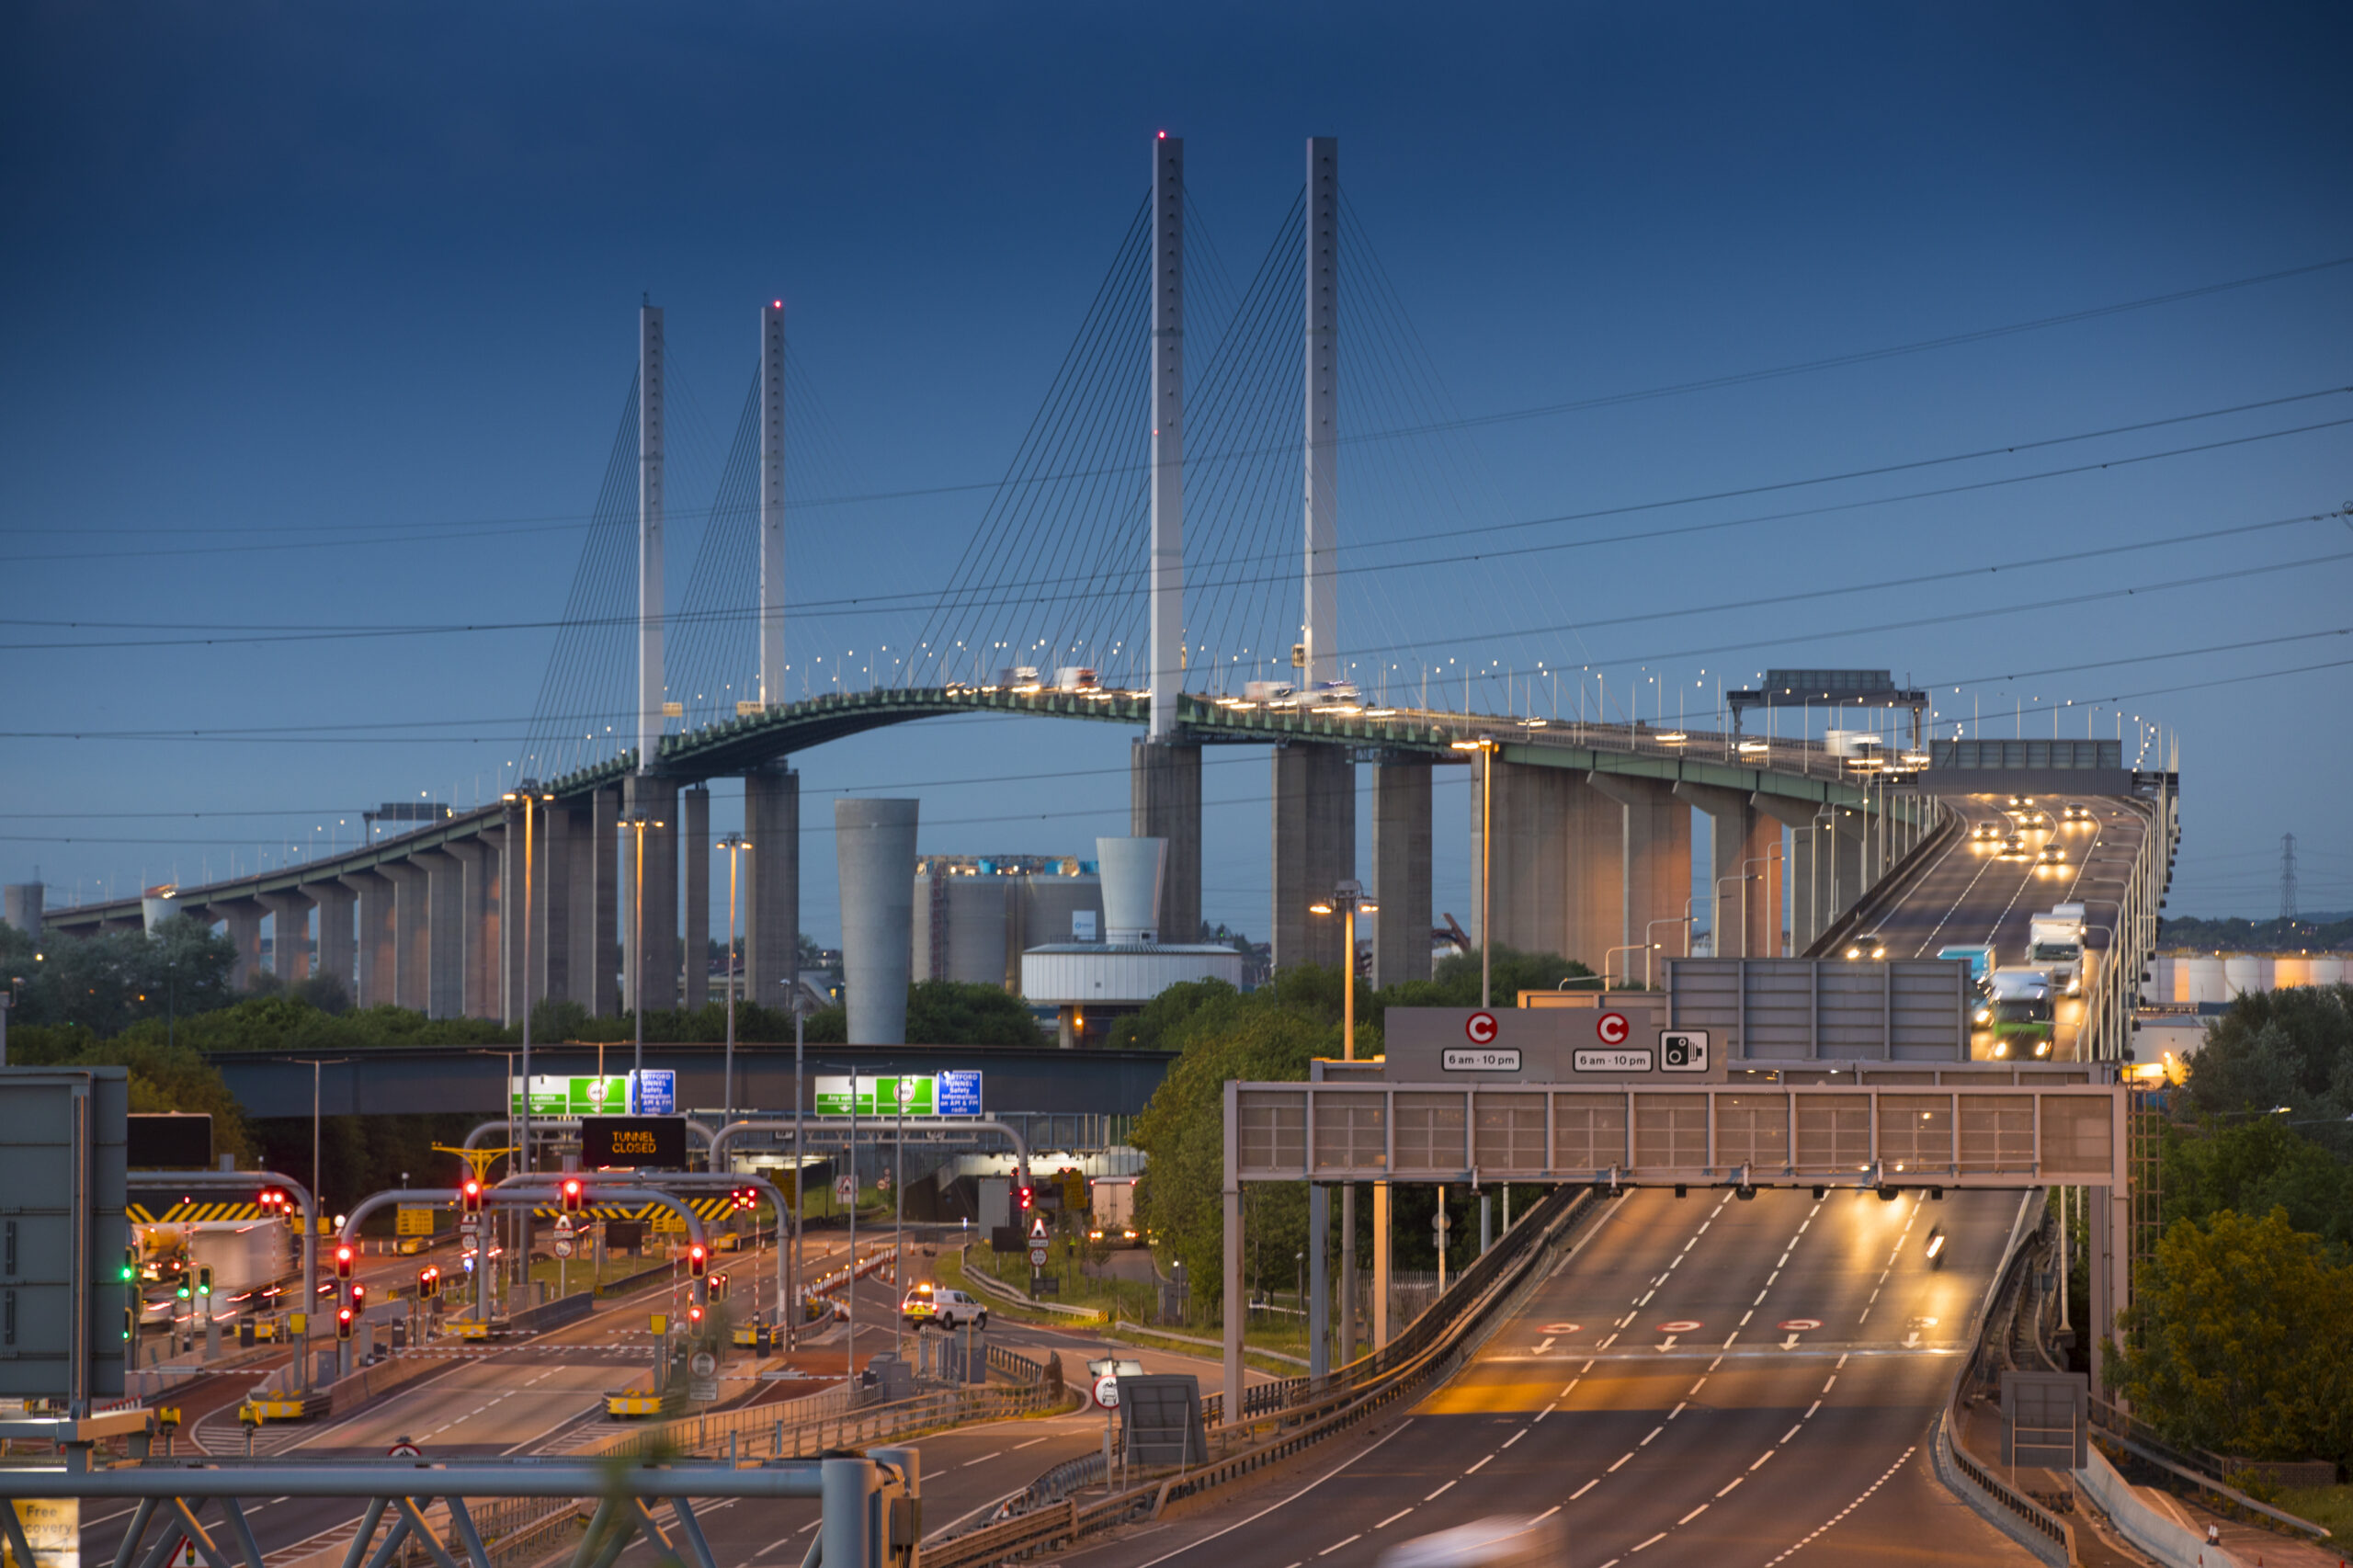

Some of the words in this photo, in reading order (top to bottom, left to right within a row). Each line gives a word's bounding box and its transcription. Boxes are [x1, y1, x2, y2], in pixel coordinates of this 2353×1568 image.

[1449, 1055, 1456, 1064] 6
[1458, 1056, 1474, 1064] am
[1483, 1055, 1495, 1064] 10
[1498, 1056, 1515, 1066] pm
[1580, 1055, 1587, 1065] 6
[1589, 1057, 1606, 1065] am
[1615, 1055, 1627, 1065] 10
[1630, 1057, 1646, 1066] pm
[827, 1095, 839, 1103] Any
[612, 1131, 655, 1142] TUNNEL
[612, 1142, 657, 1153] CLOSED
[27, 1505, 57, 1517] Free
[25, 1524, 72, 1536] covery
